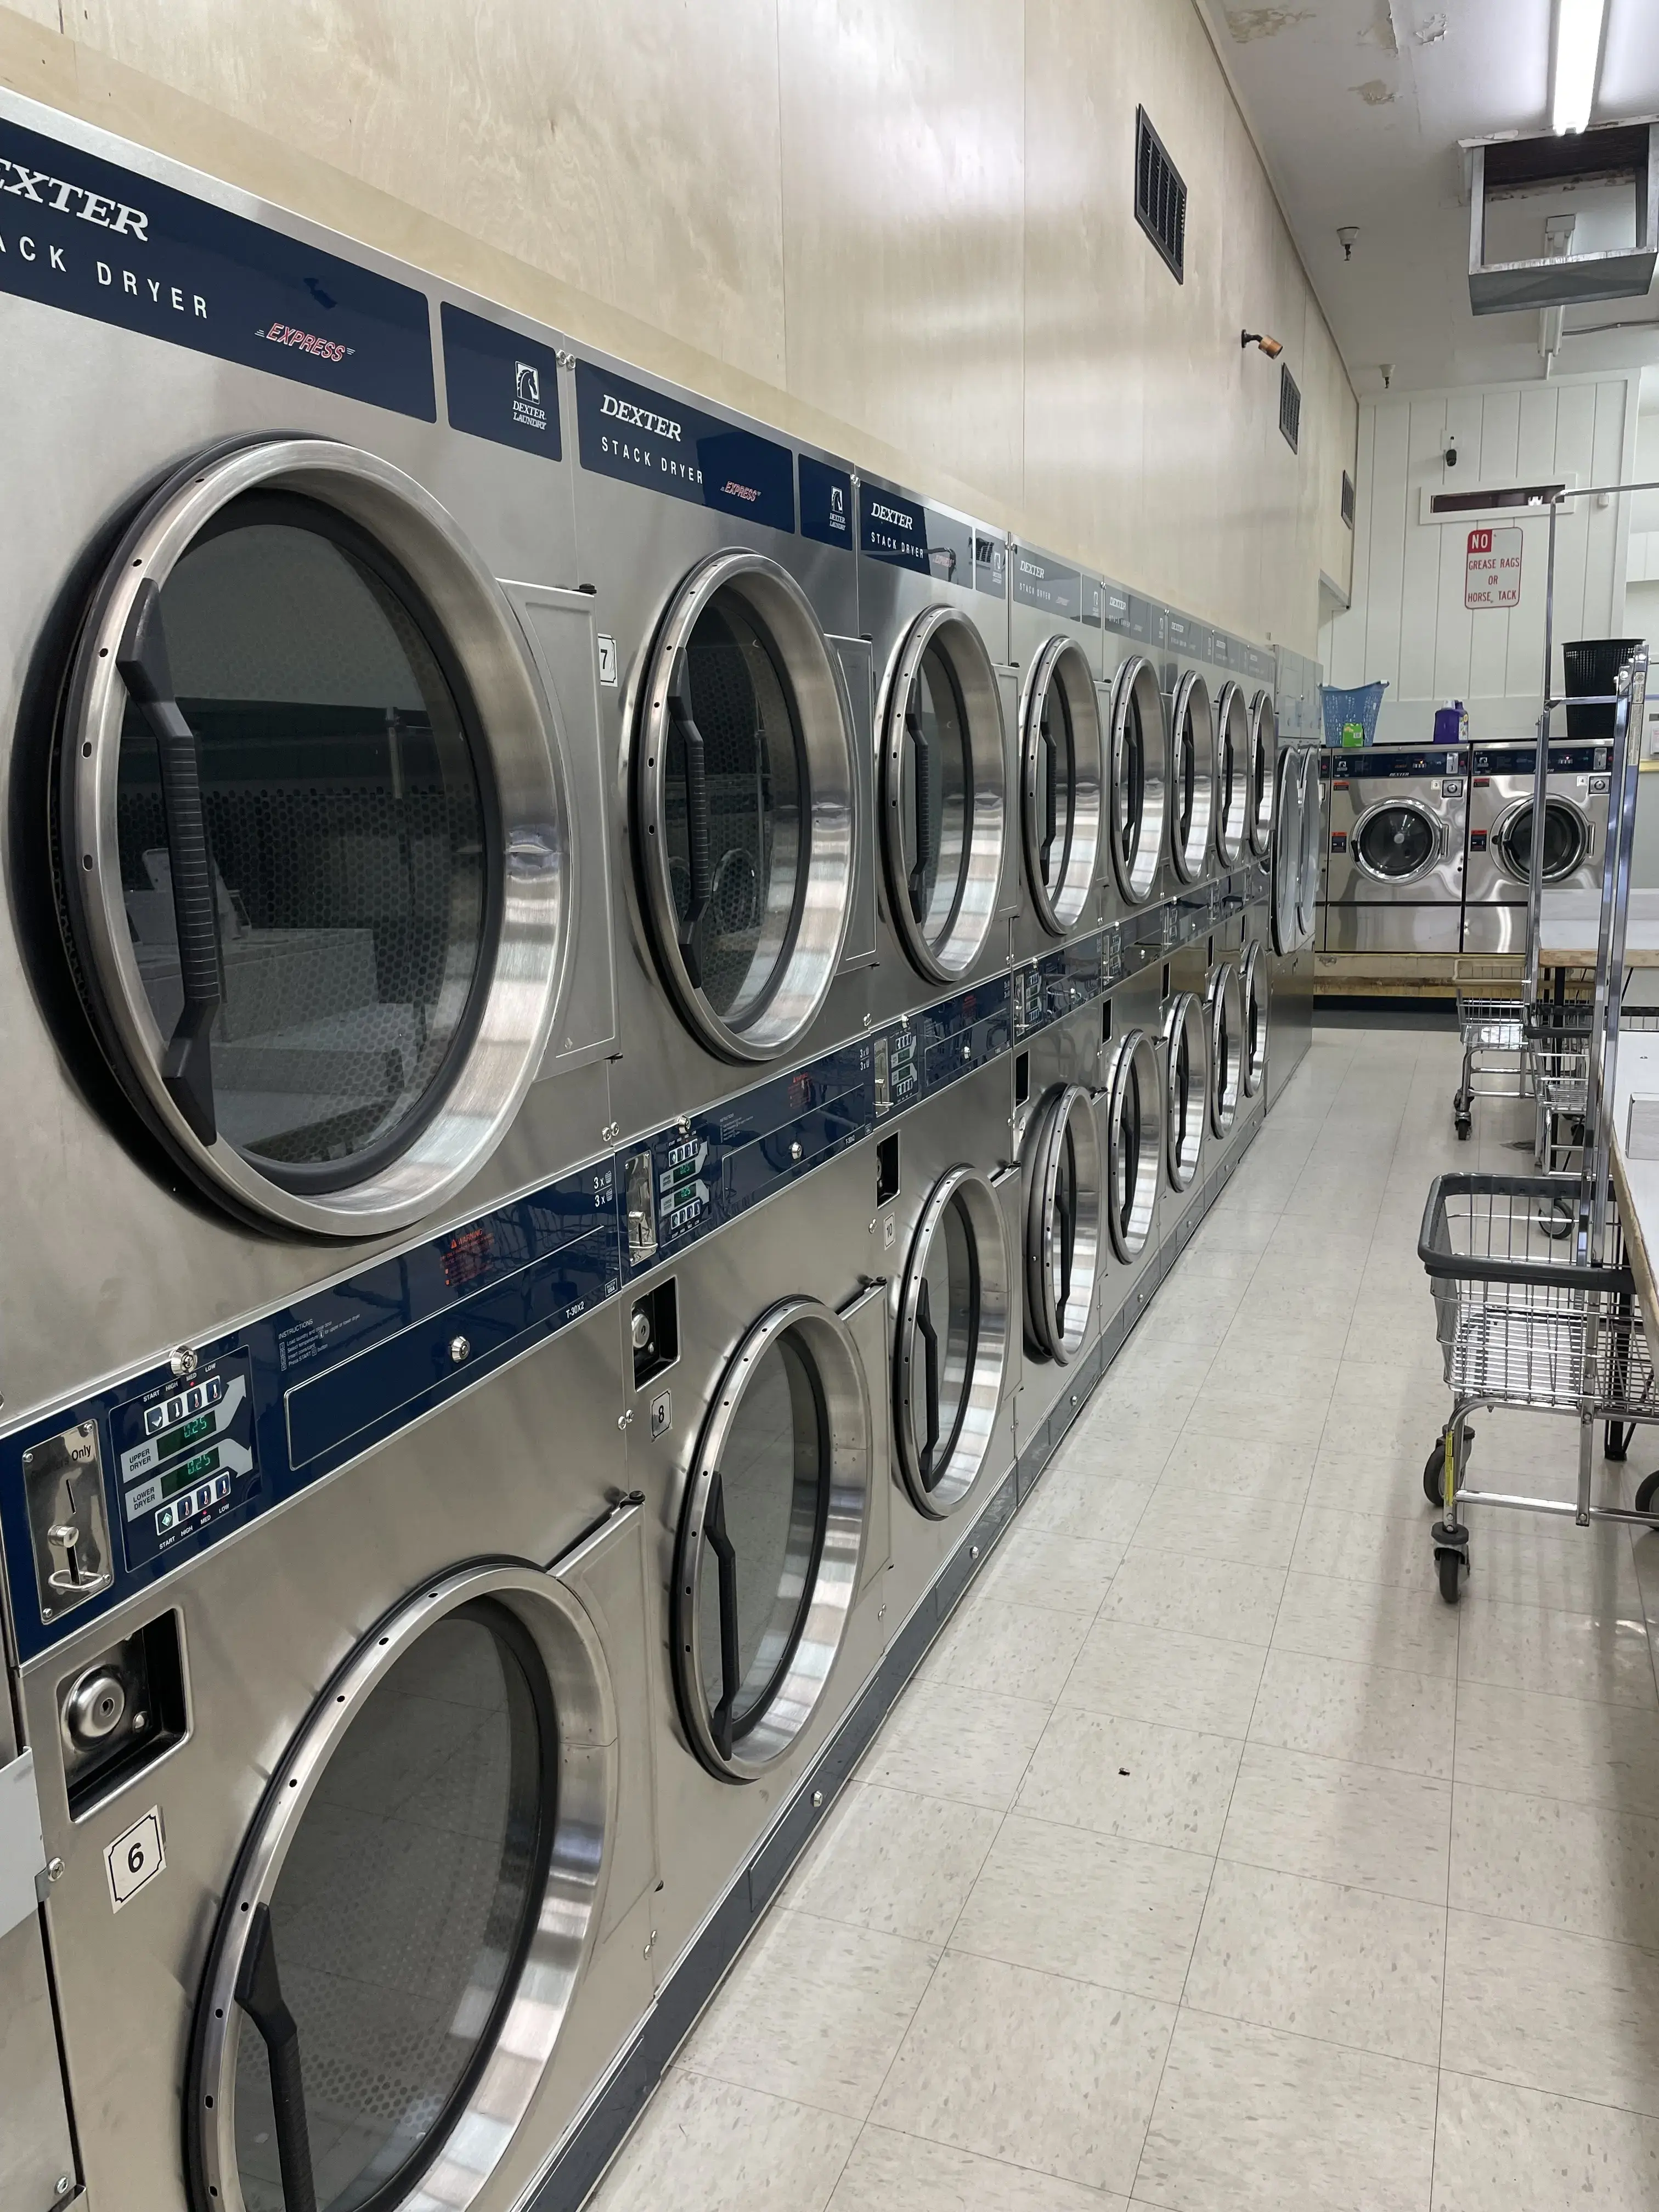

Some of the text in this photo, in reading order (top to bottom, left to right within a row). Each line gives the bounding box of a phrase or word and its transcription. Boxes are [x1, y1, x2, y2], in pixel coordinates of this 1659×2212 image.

[97, 261, 207, 319] DRYER
[267, 323, 345, 362] EXPRESS
[512, 400, 545, 420] DEXTER
[600, 394, 681, 442] DEXTER
[513, 412, 547, 430] LAUNDRY
[602, 437, 703, 484] STACK DRYER
[725, 481, 757, 501] EXPRESS
[871, 503, 913, 530] DEXTER
[871, 532, 923, 558] STACK DRYER
[1471, 533, 1488, 549] NO
[1020, 560, 1045, 579] DEXTER
[1469, 557, 1520, 569] GREASE RAGS
[1019, 583, 1034, 595] STACK
[1488, 575, 1498, 585] OR
[1109, 596, 1126, 610] DEXTER
[1498, 590, 1516, 600] TACK
[600, 648, 607, 669] 7
[594, 1176, 599, 1189] 3
[595, 1195, 600, 1207] 3
[886, 1222, 893, 1237] 10
[566, 1301, 584, 1319] T-30X2
[278, 1318, 313, 1340] INSTRUCTIONS
[287, 1345, 298, 1353] Select
[299, 1351, 311, 1362] START
[143, 1363, 217, 1402] START HIGH MED LOW
[658, 1405, 664, 1423] 8
[71, 1445, 91, 1461] Only
[129, 1448, 150, 1464] UPPER
[130, 1455, 151, 1472] DRYER
[133, 1486, 155, 1503] LOWER
[134, 1494, 155, 1511] DRYER
[159, 1503, 230, 1549] START HIGH MED LOW
[127, 1843, 144, 1873] 6
